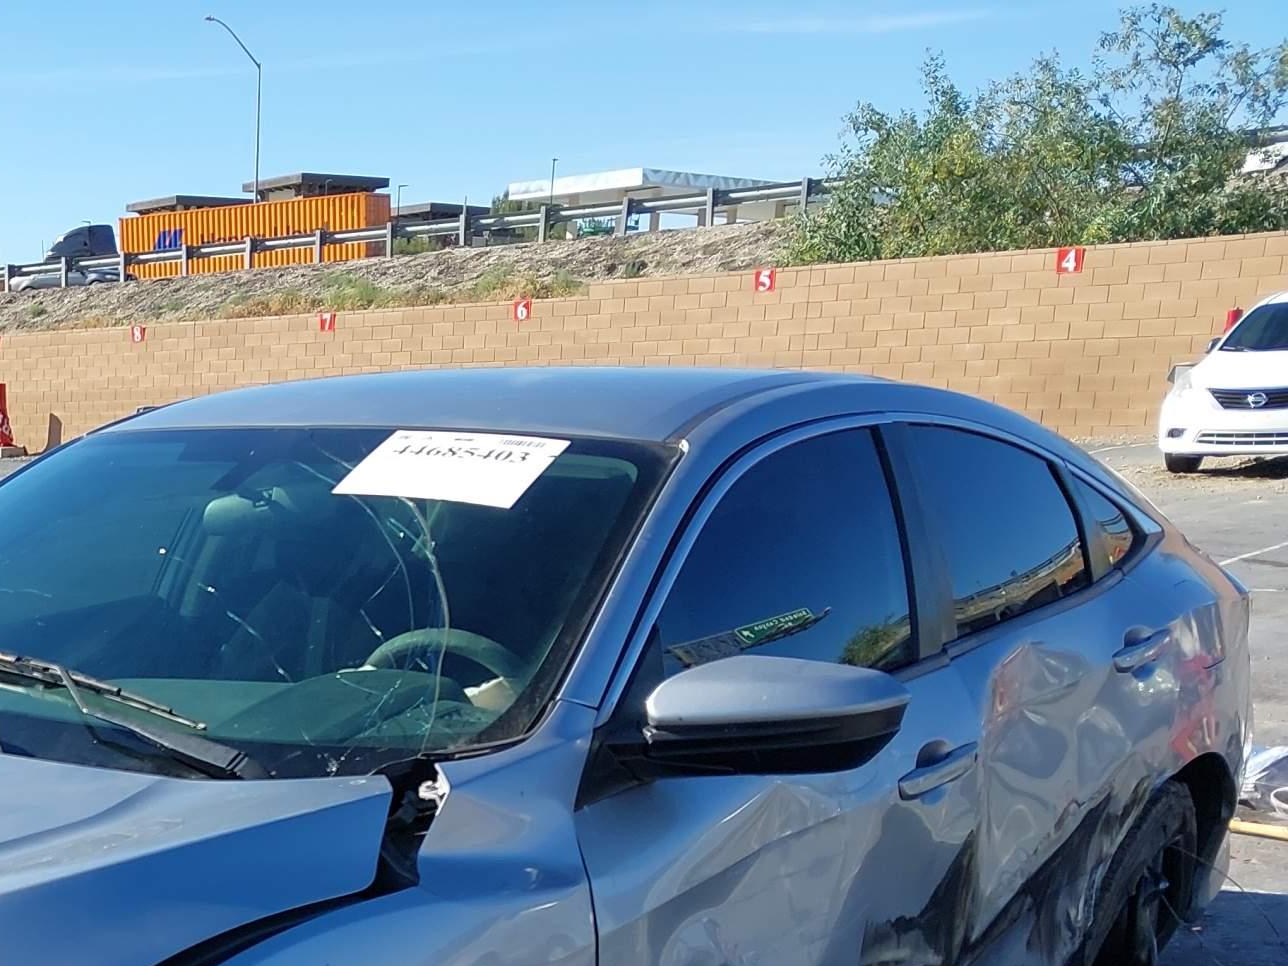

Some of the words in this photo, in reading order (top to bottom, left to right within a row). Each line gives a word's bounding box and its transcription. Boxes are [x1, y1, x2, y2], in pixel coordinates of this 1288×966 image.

[1061, 248, 1077, 272] 4
[758, 269, 771, 291] 5
[516, 300, 528, 320] 6
[322, 312, 332, 331] 7
[133, 326, 142, 342] 8
[393, 444, 531, 464] 44685403
